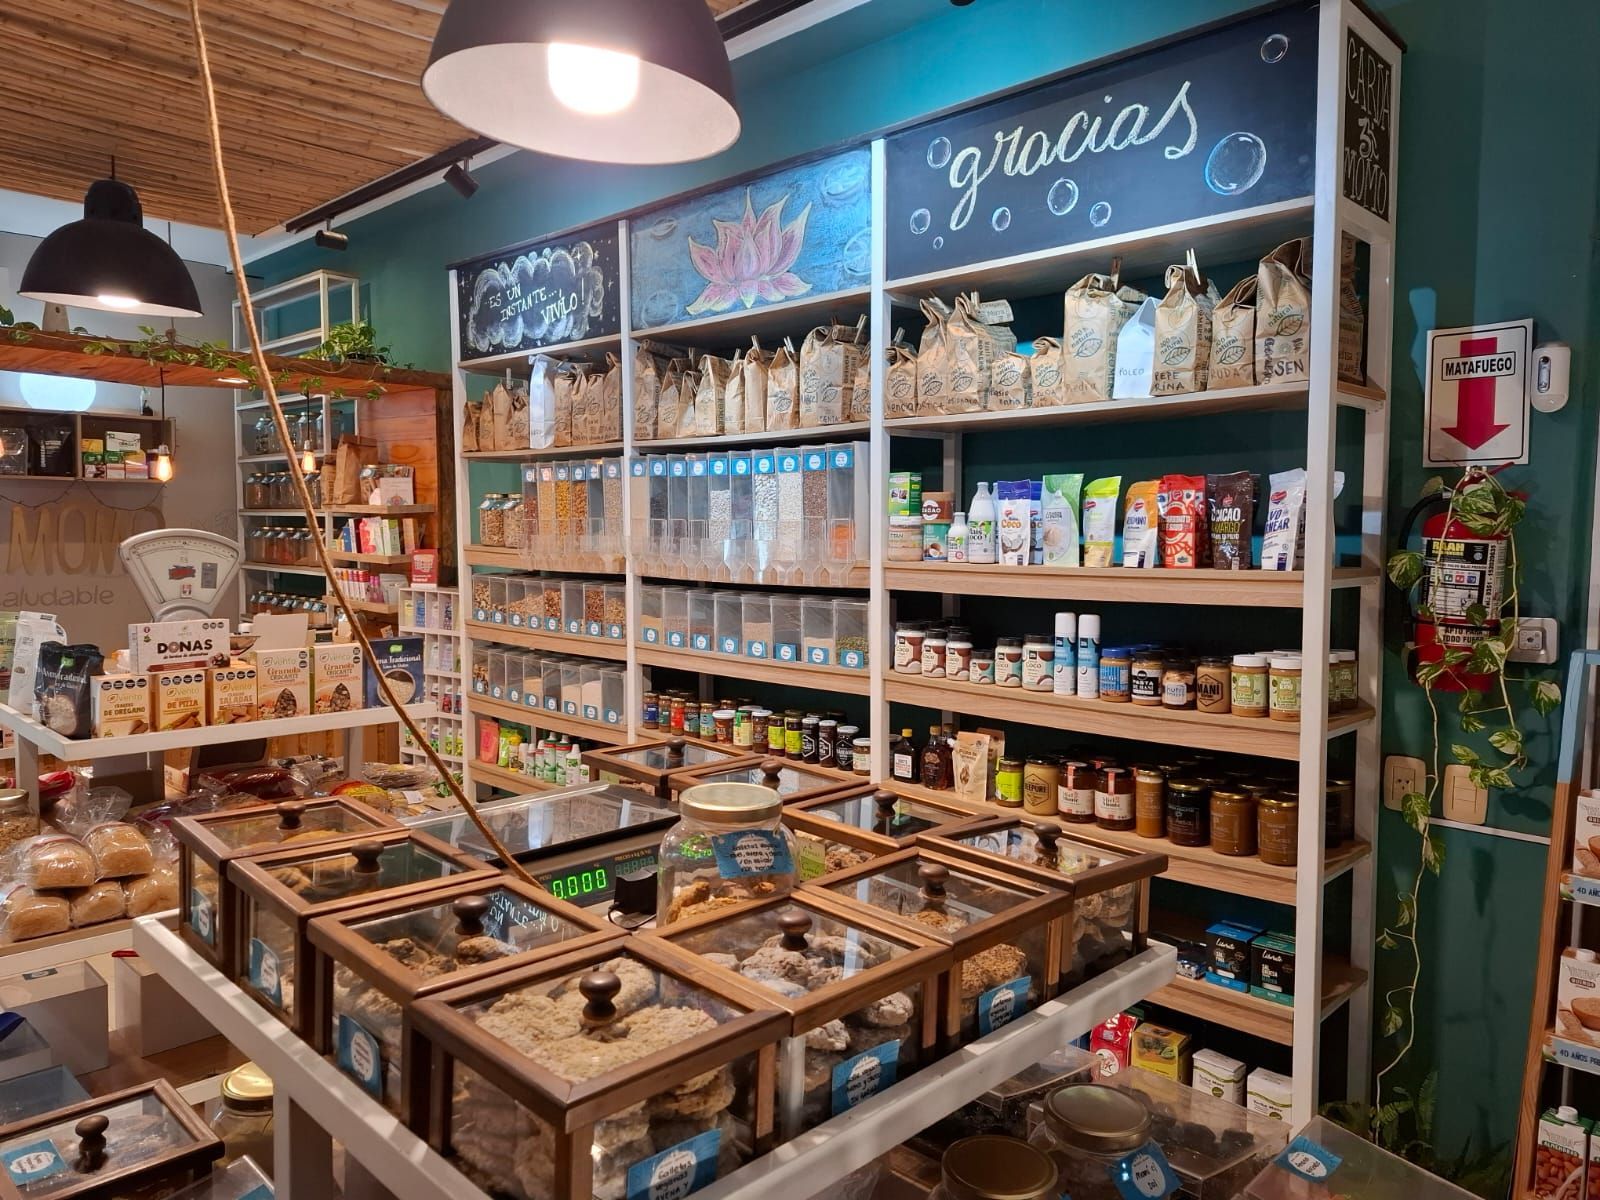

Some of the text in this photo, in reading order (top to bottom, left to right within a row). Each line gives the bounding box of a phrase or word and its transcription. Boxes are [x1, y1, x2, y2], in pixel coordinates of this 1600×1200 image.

[949, 81, 1198, 230] gracias
[1344, 147, 1387, 215] MOMO
[488, 283, 522, 308] ES UN
[1155, 371, 1180, 380] PEPE
[1274, 359, 1304, 376] SEN
[1445, 356, 1513, 377] MATAFUEGO
[157, 639, 213, 654] DONAS
[552, 869, 606, 899] 0.000
